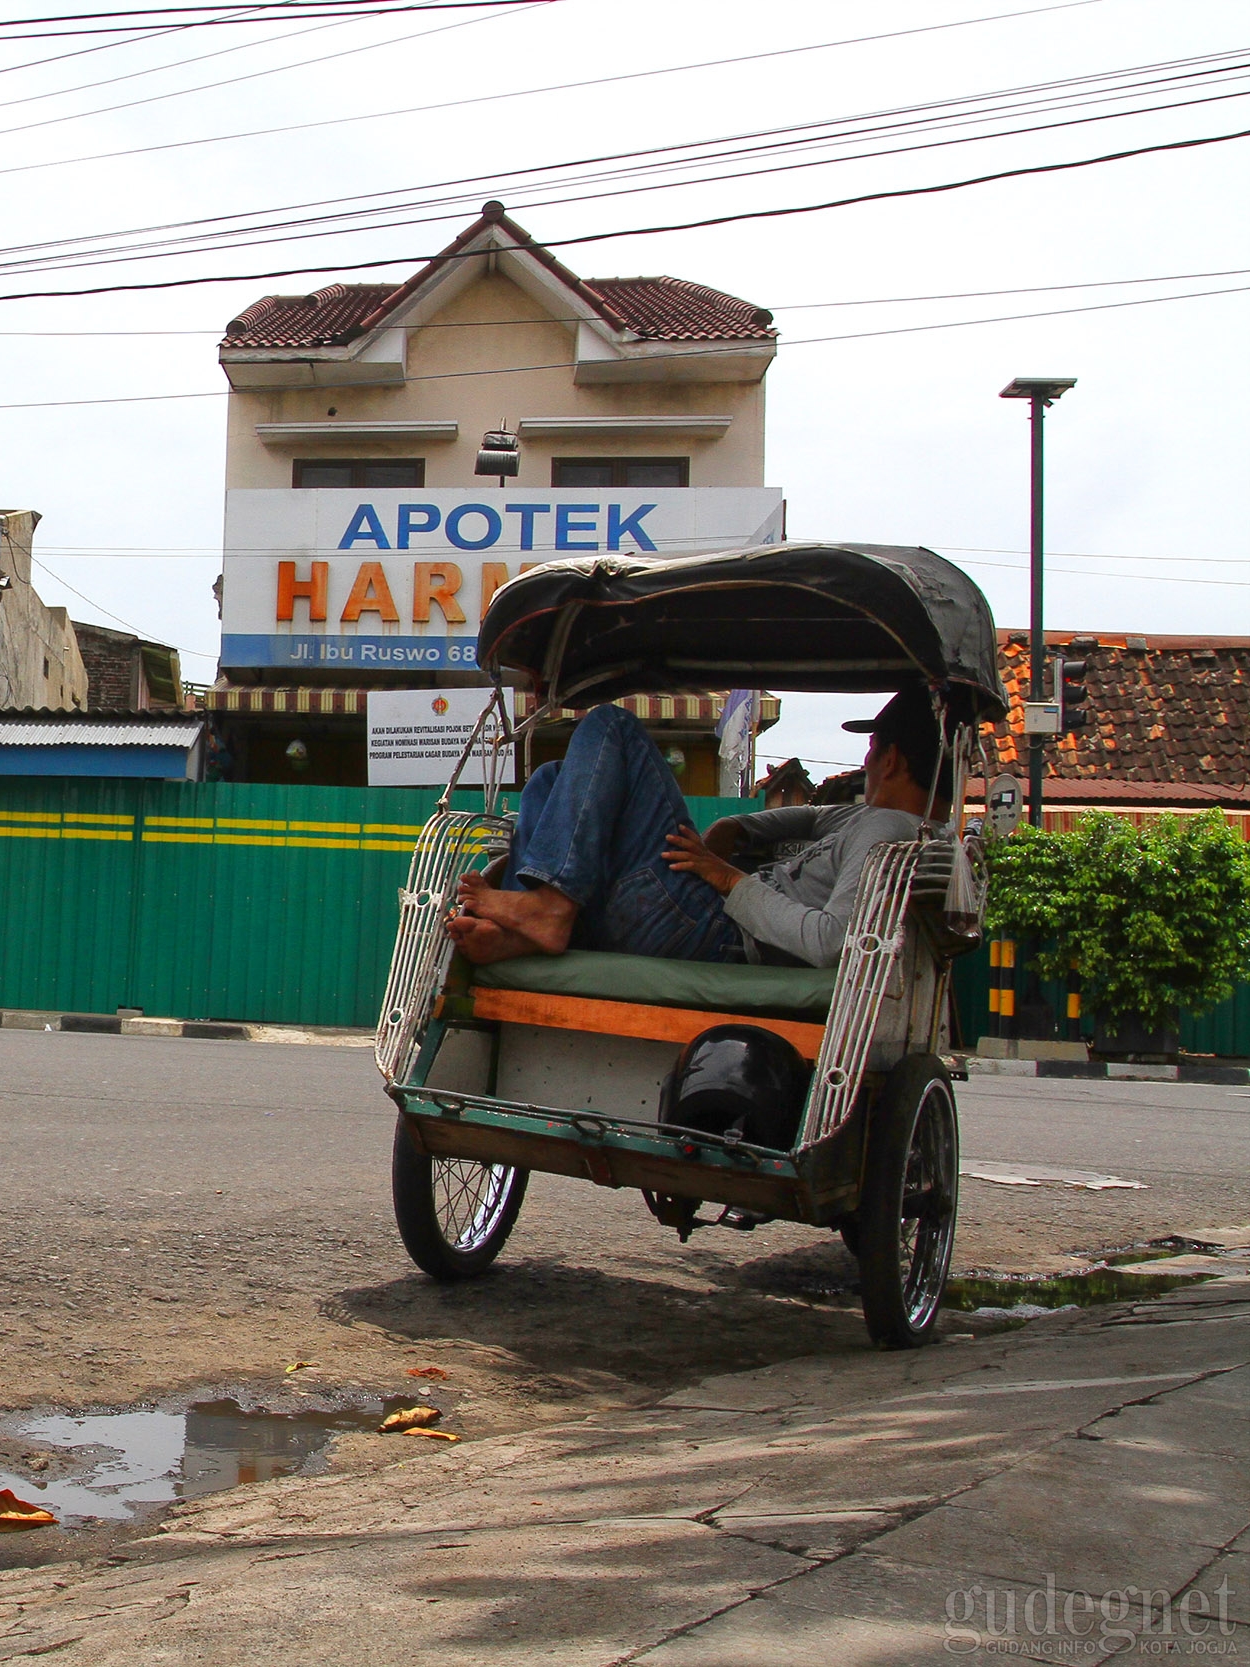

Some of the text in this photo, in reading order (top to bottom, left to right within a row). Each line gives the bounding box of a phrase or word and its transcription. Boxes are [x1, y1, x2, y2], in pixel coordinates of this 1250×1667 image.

[337, 503, 659, 552] APOTEK
[290, 643, 313, 660] Jl.
[319, 643, 353, 660] Ibu
[360, 644, 440, 662] Ruswo
[386, 726, 413, 734] DILAKUKAN
[414, 725, 445, 734] REVITALISASI
[446, 725, 462, 733] POJOK
[395, 738, 418, 746] NOMINASI
[419, 738, 440, 746] WARISAN
[441, 737, 459, 745] BUDAYA
[370, 751, 392, 759] PROGRAM
[393, 751, 424, 759] PELESTARIAN
[425, 750, 441, 758] CAGAR
[442, 750, 460, 758] BUDAYA
